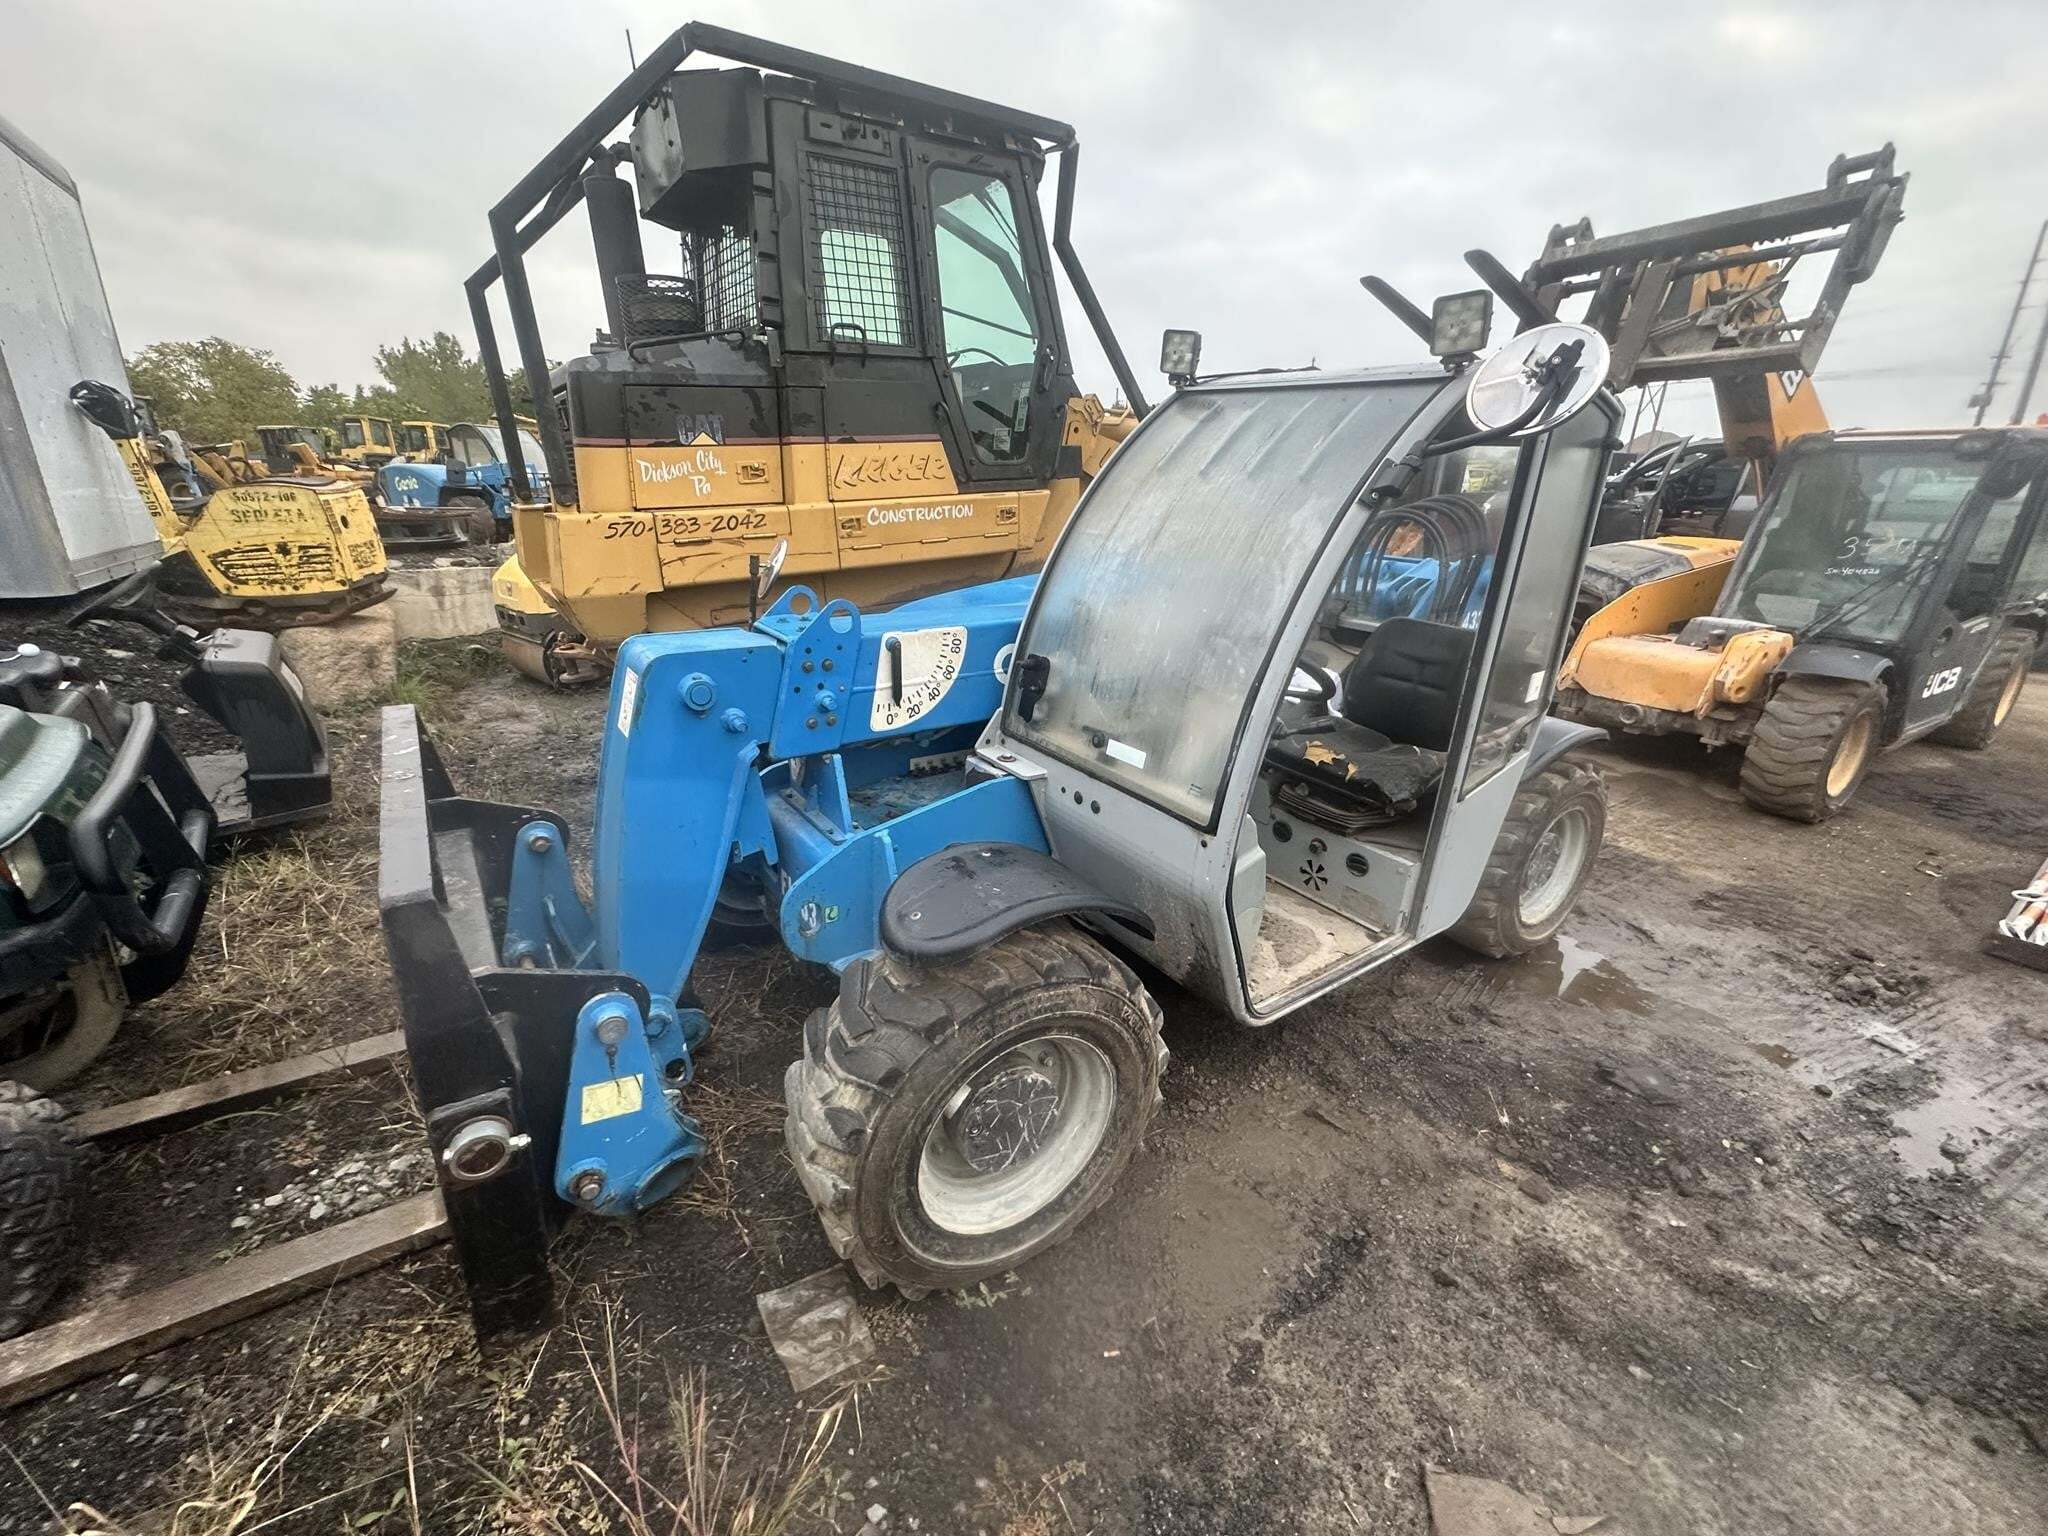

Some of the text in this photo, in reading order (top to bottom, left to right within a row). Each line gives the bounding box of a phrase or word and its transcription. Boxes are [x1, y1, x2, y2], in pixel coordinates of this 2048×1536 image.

[636, 449, 727, 483] Dickson City
[689, 475, 712, 498] Pa
[1922, 666, 1963, 699] JCB
